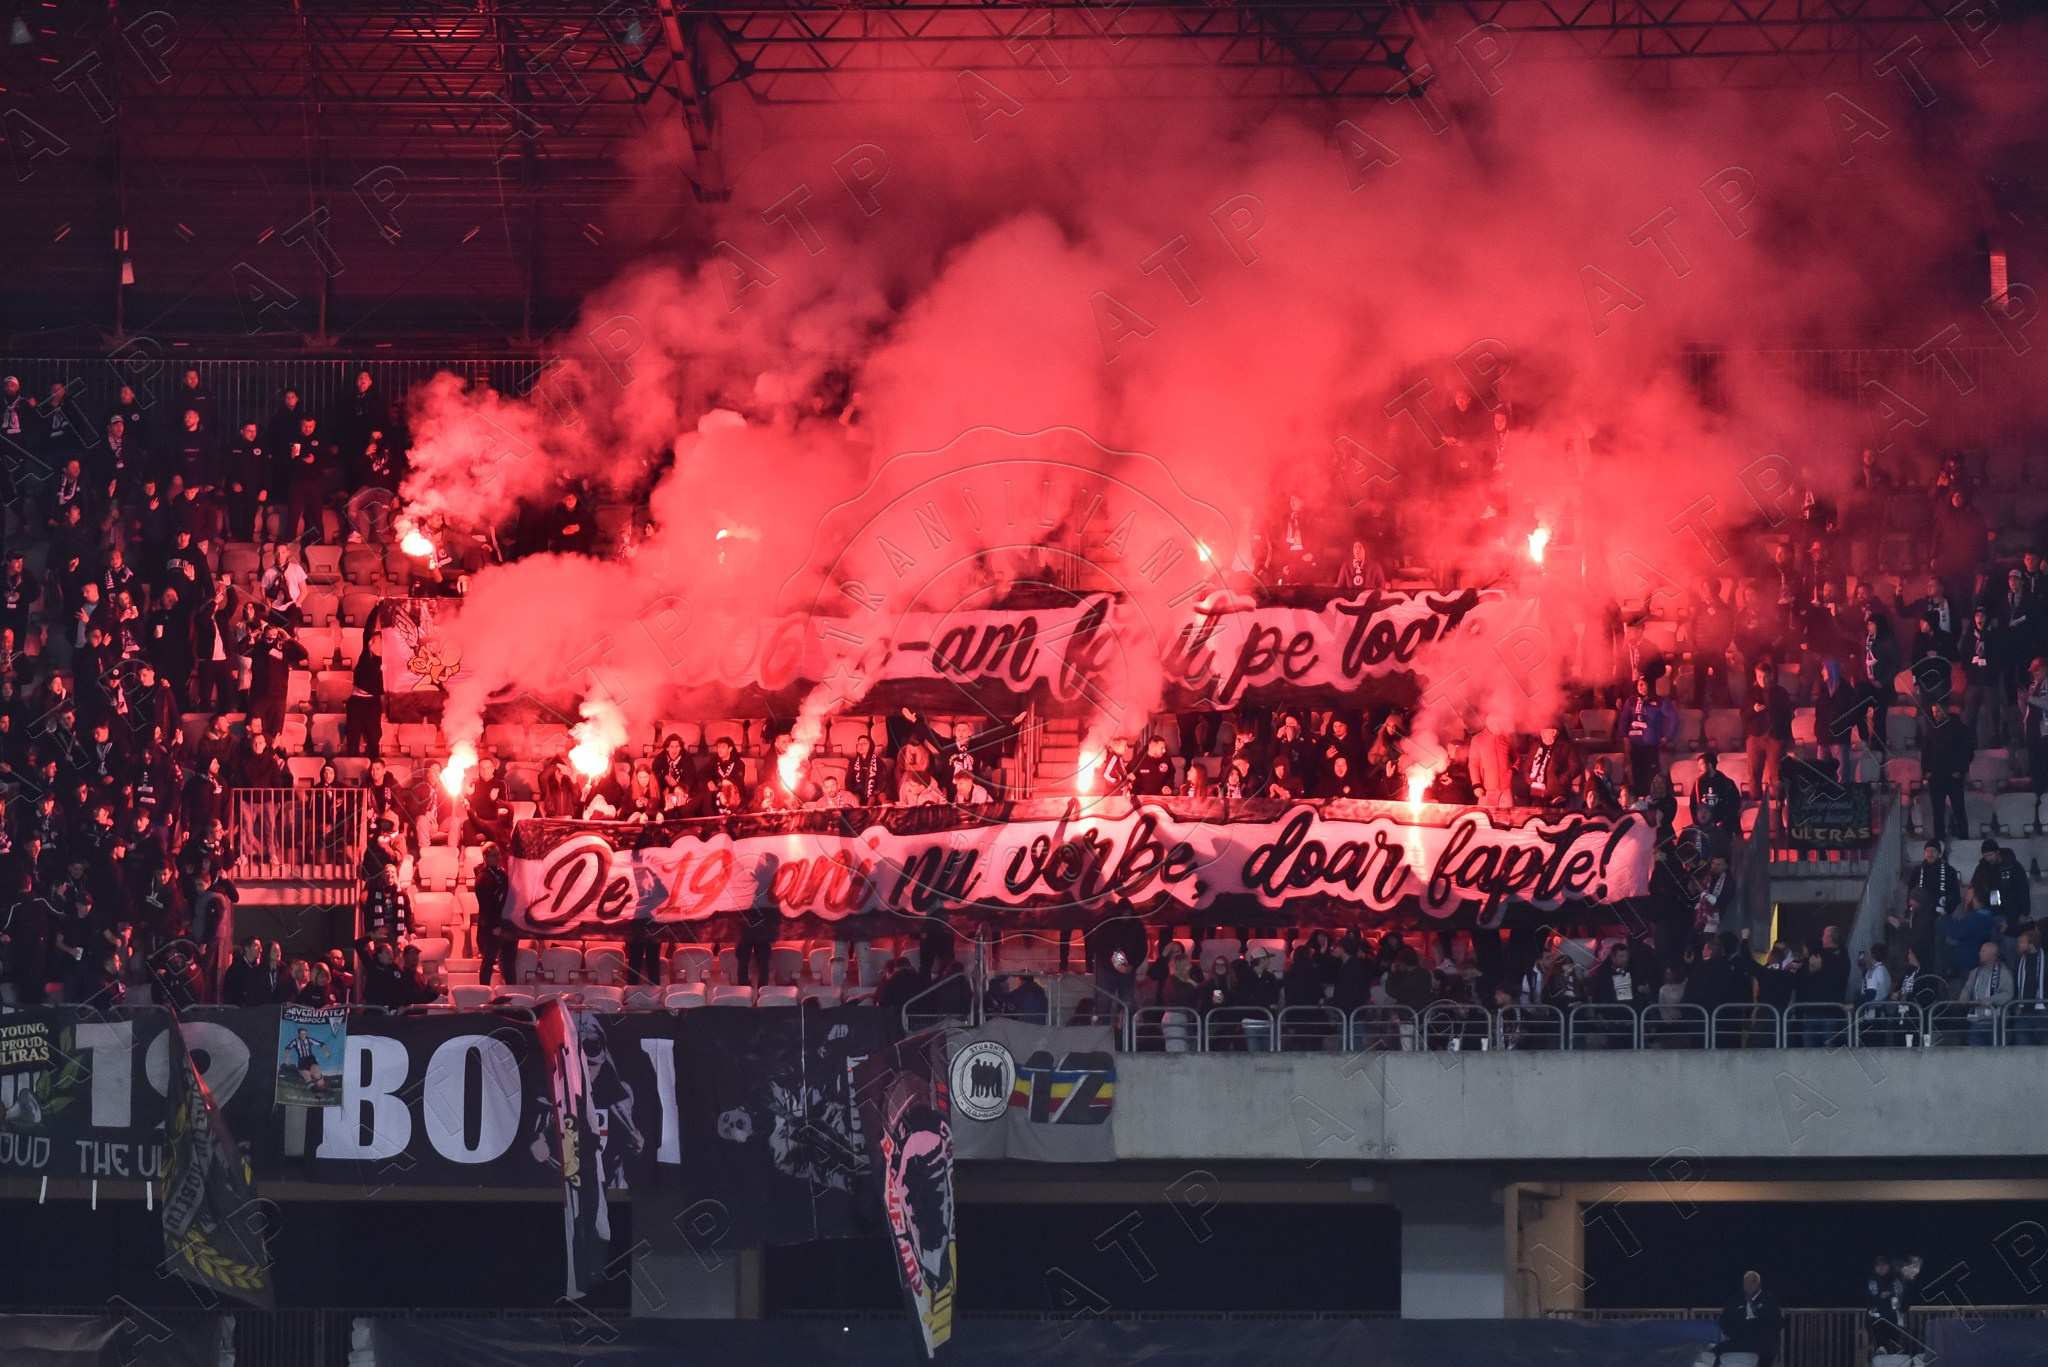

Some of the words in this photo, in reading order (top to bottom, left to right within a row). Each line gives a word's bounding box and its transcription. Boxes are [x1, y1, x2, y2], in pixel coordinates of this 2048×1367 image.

[1217, 621, 1318, 704] pe
[524, 843, 633, 930] De
[654, 846, 734, 917] 19
[767, 834, 881, 914] ani
[891, 845, 982, 914] nu
[1242, 807, 1410, 904] doar
[1429, 816, 1635, 926] fapte!
[0, 1022, 50, 1039] YOUNG,
[1, 1036, 49, 1051] PROUD,
[0, 1046, 51, 1066] LTRAS
[75, 1139, 130, 1177] THE
